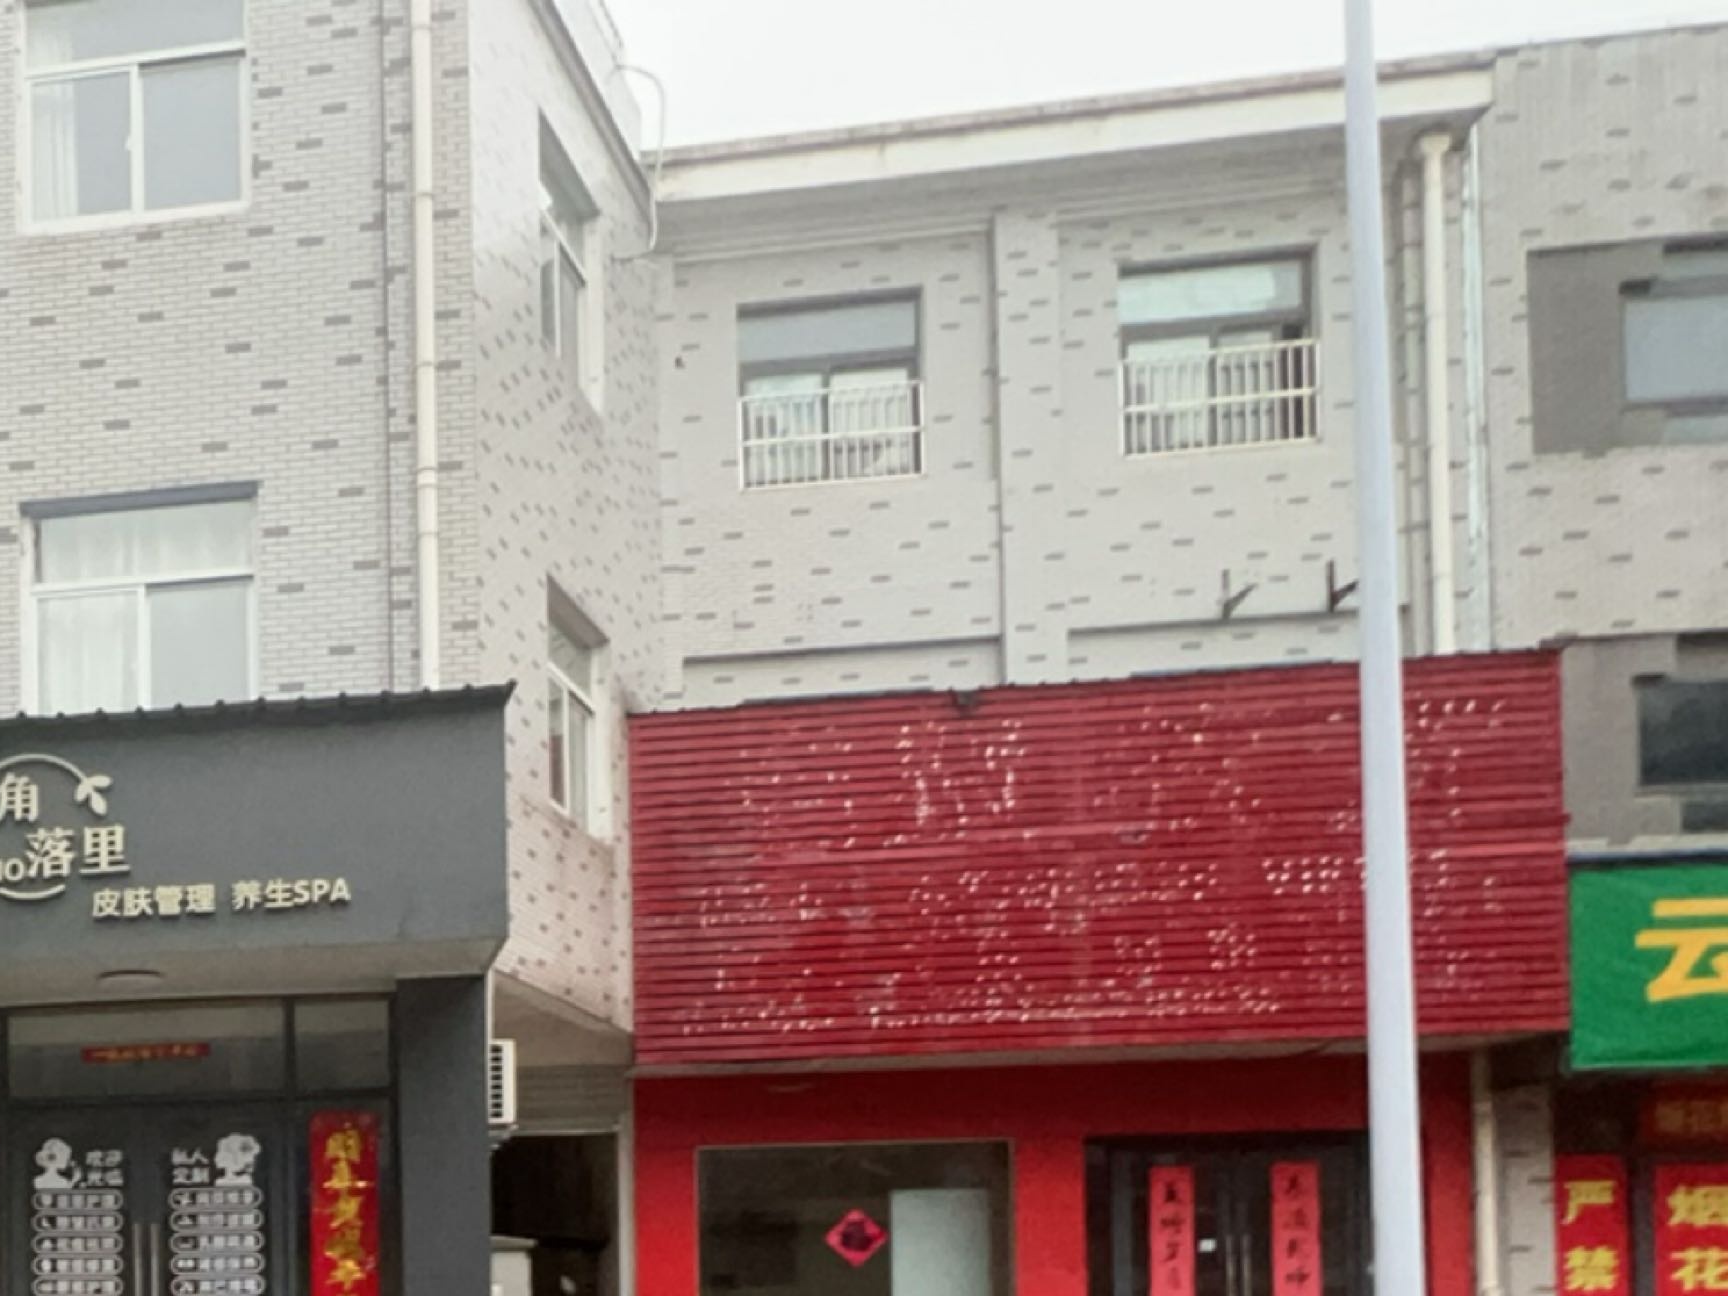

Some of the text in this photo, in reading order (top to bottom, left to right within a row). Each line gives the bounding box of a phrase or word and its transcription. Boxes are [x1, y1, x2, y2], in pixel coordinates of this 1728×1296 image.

[25, 824, 131, 880] 落里
[91, 877, 351, 919] 皮肤管理 养生SPA
[1634, 897, 1728, 1004] 云
